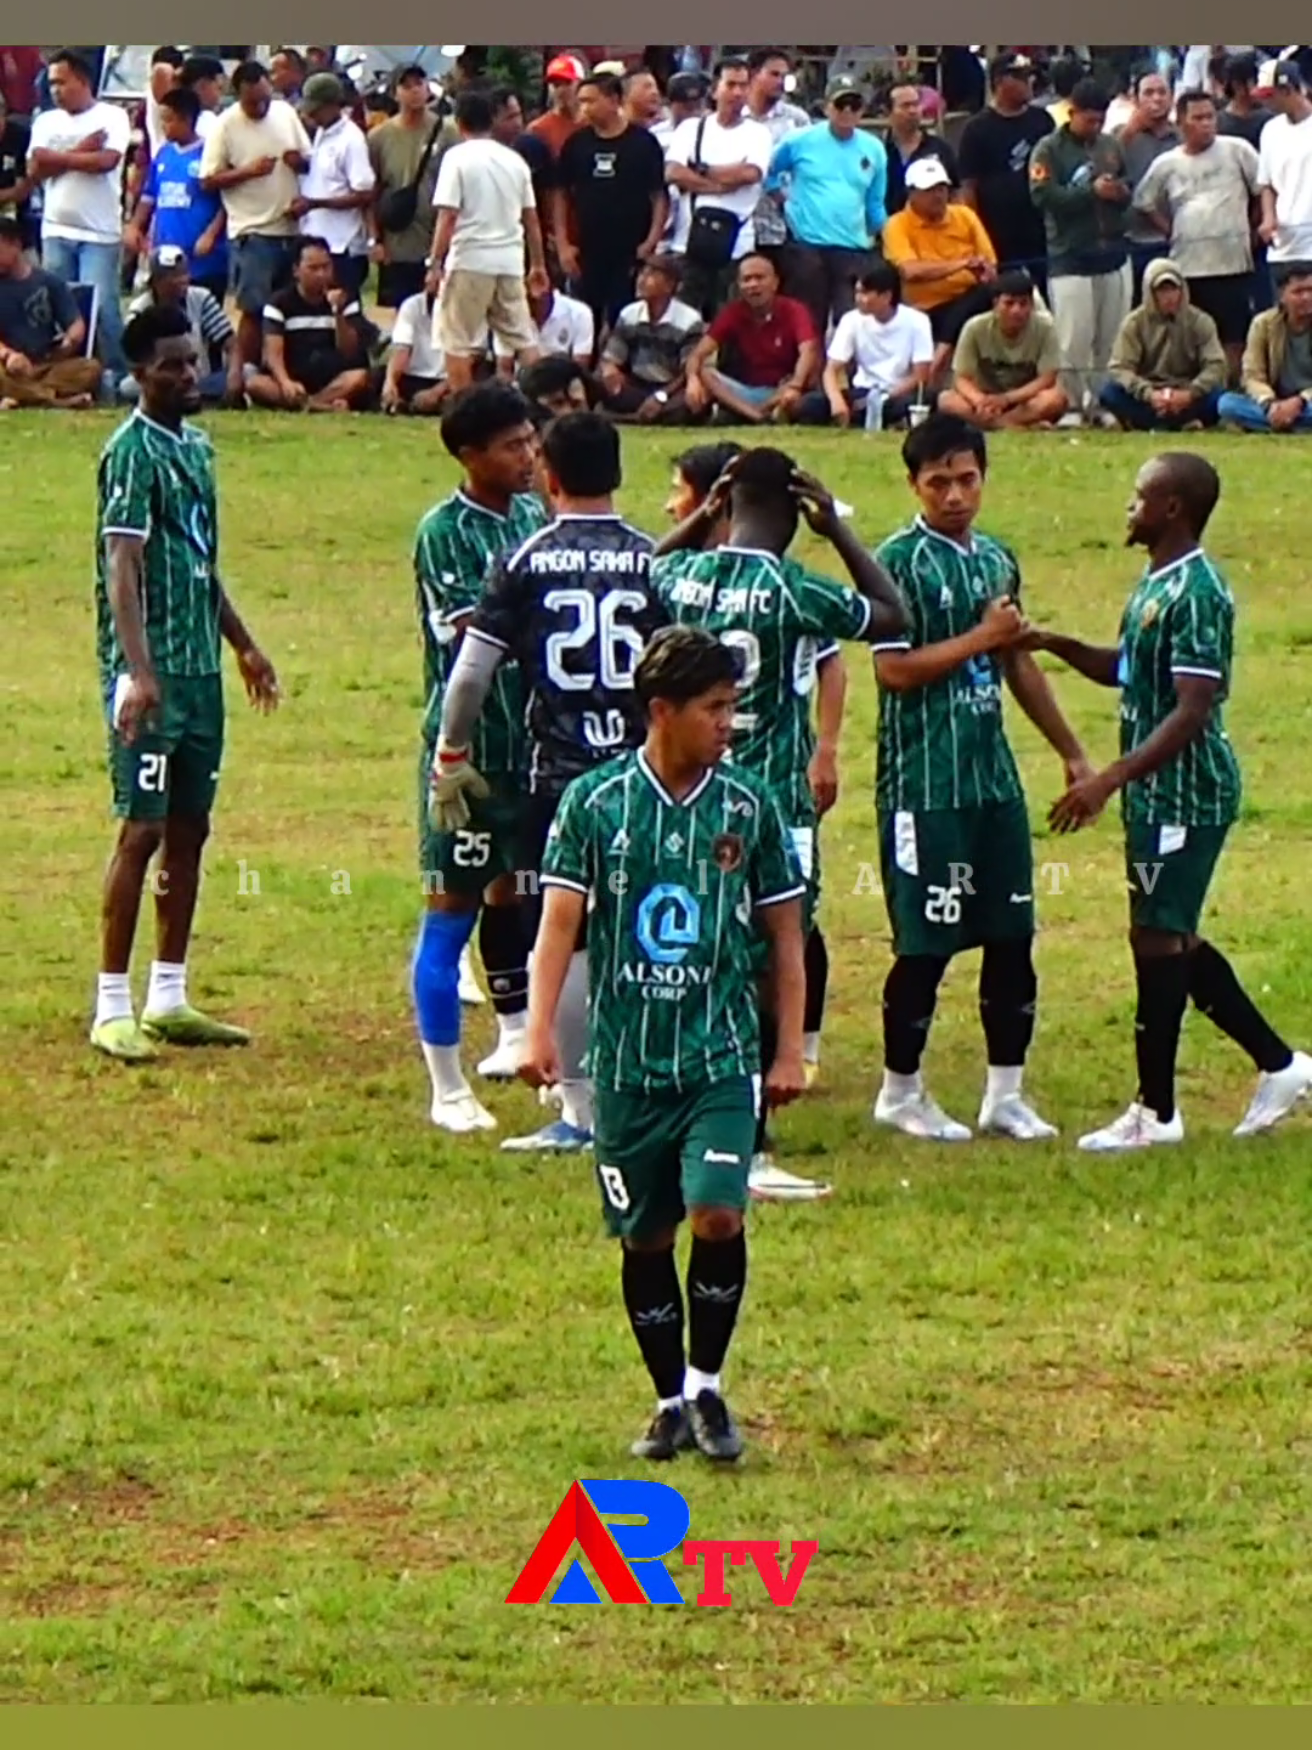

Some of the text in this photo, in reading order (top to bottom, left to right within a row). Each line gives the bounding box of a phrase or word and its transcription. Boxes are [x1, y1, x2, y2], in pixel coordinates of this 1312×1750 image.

[543, 589, 648, 691] 26
[138, 753, 167, 793] 21
[453, 829, 491, 867] 25
[924, 884, 962, 925] 26
